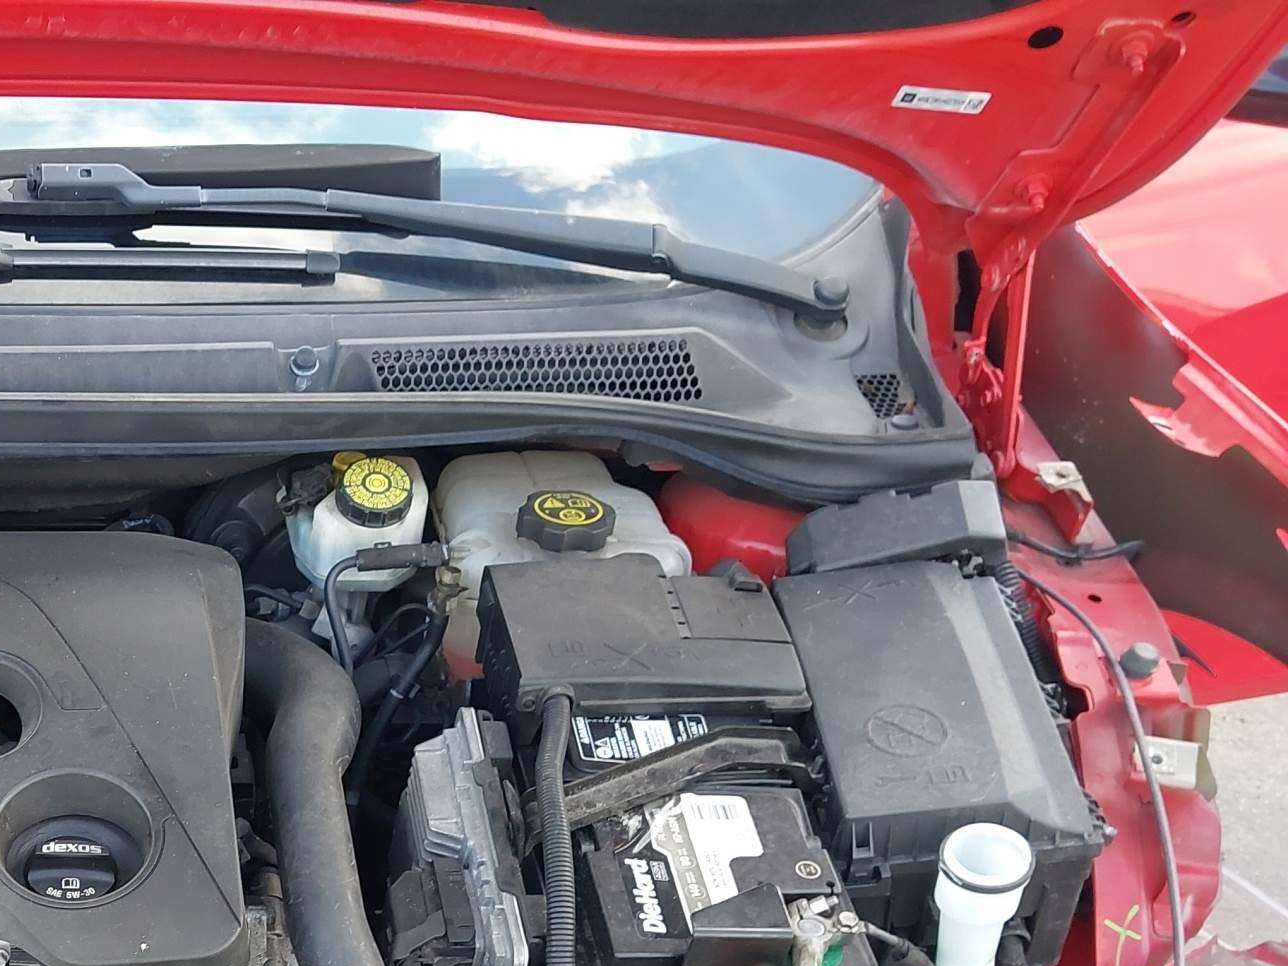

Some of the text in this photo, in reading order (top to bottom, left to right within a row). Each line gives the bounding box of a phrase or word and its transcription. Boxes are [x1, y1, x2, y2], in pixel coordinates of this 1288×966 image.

[42, 841, 102, 853] dexos
[46, 887, 96, 899] SAE 5W-30
[624, 858, 668, 934] DieHard
